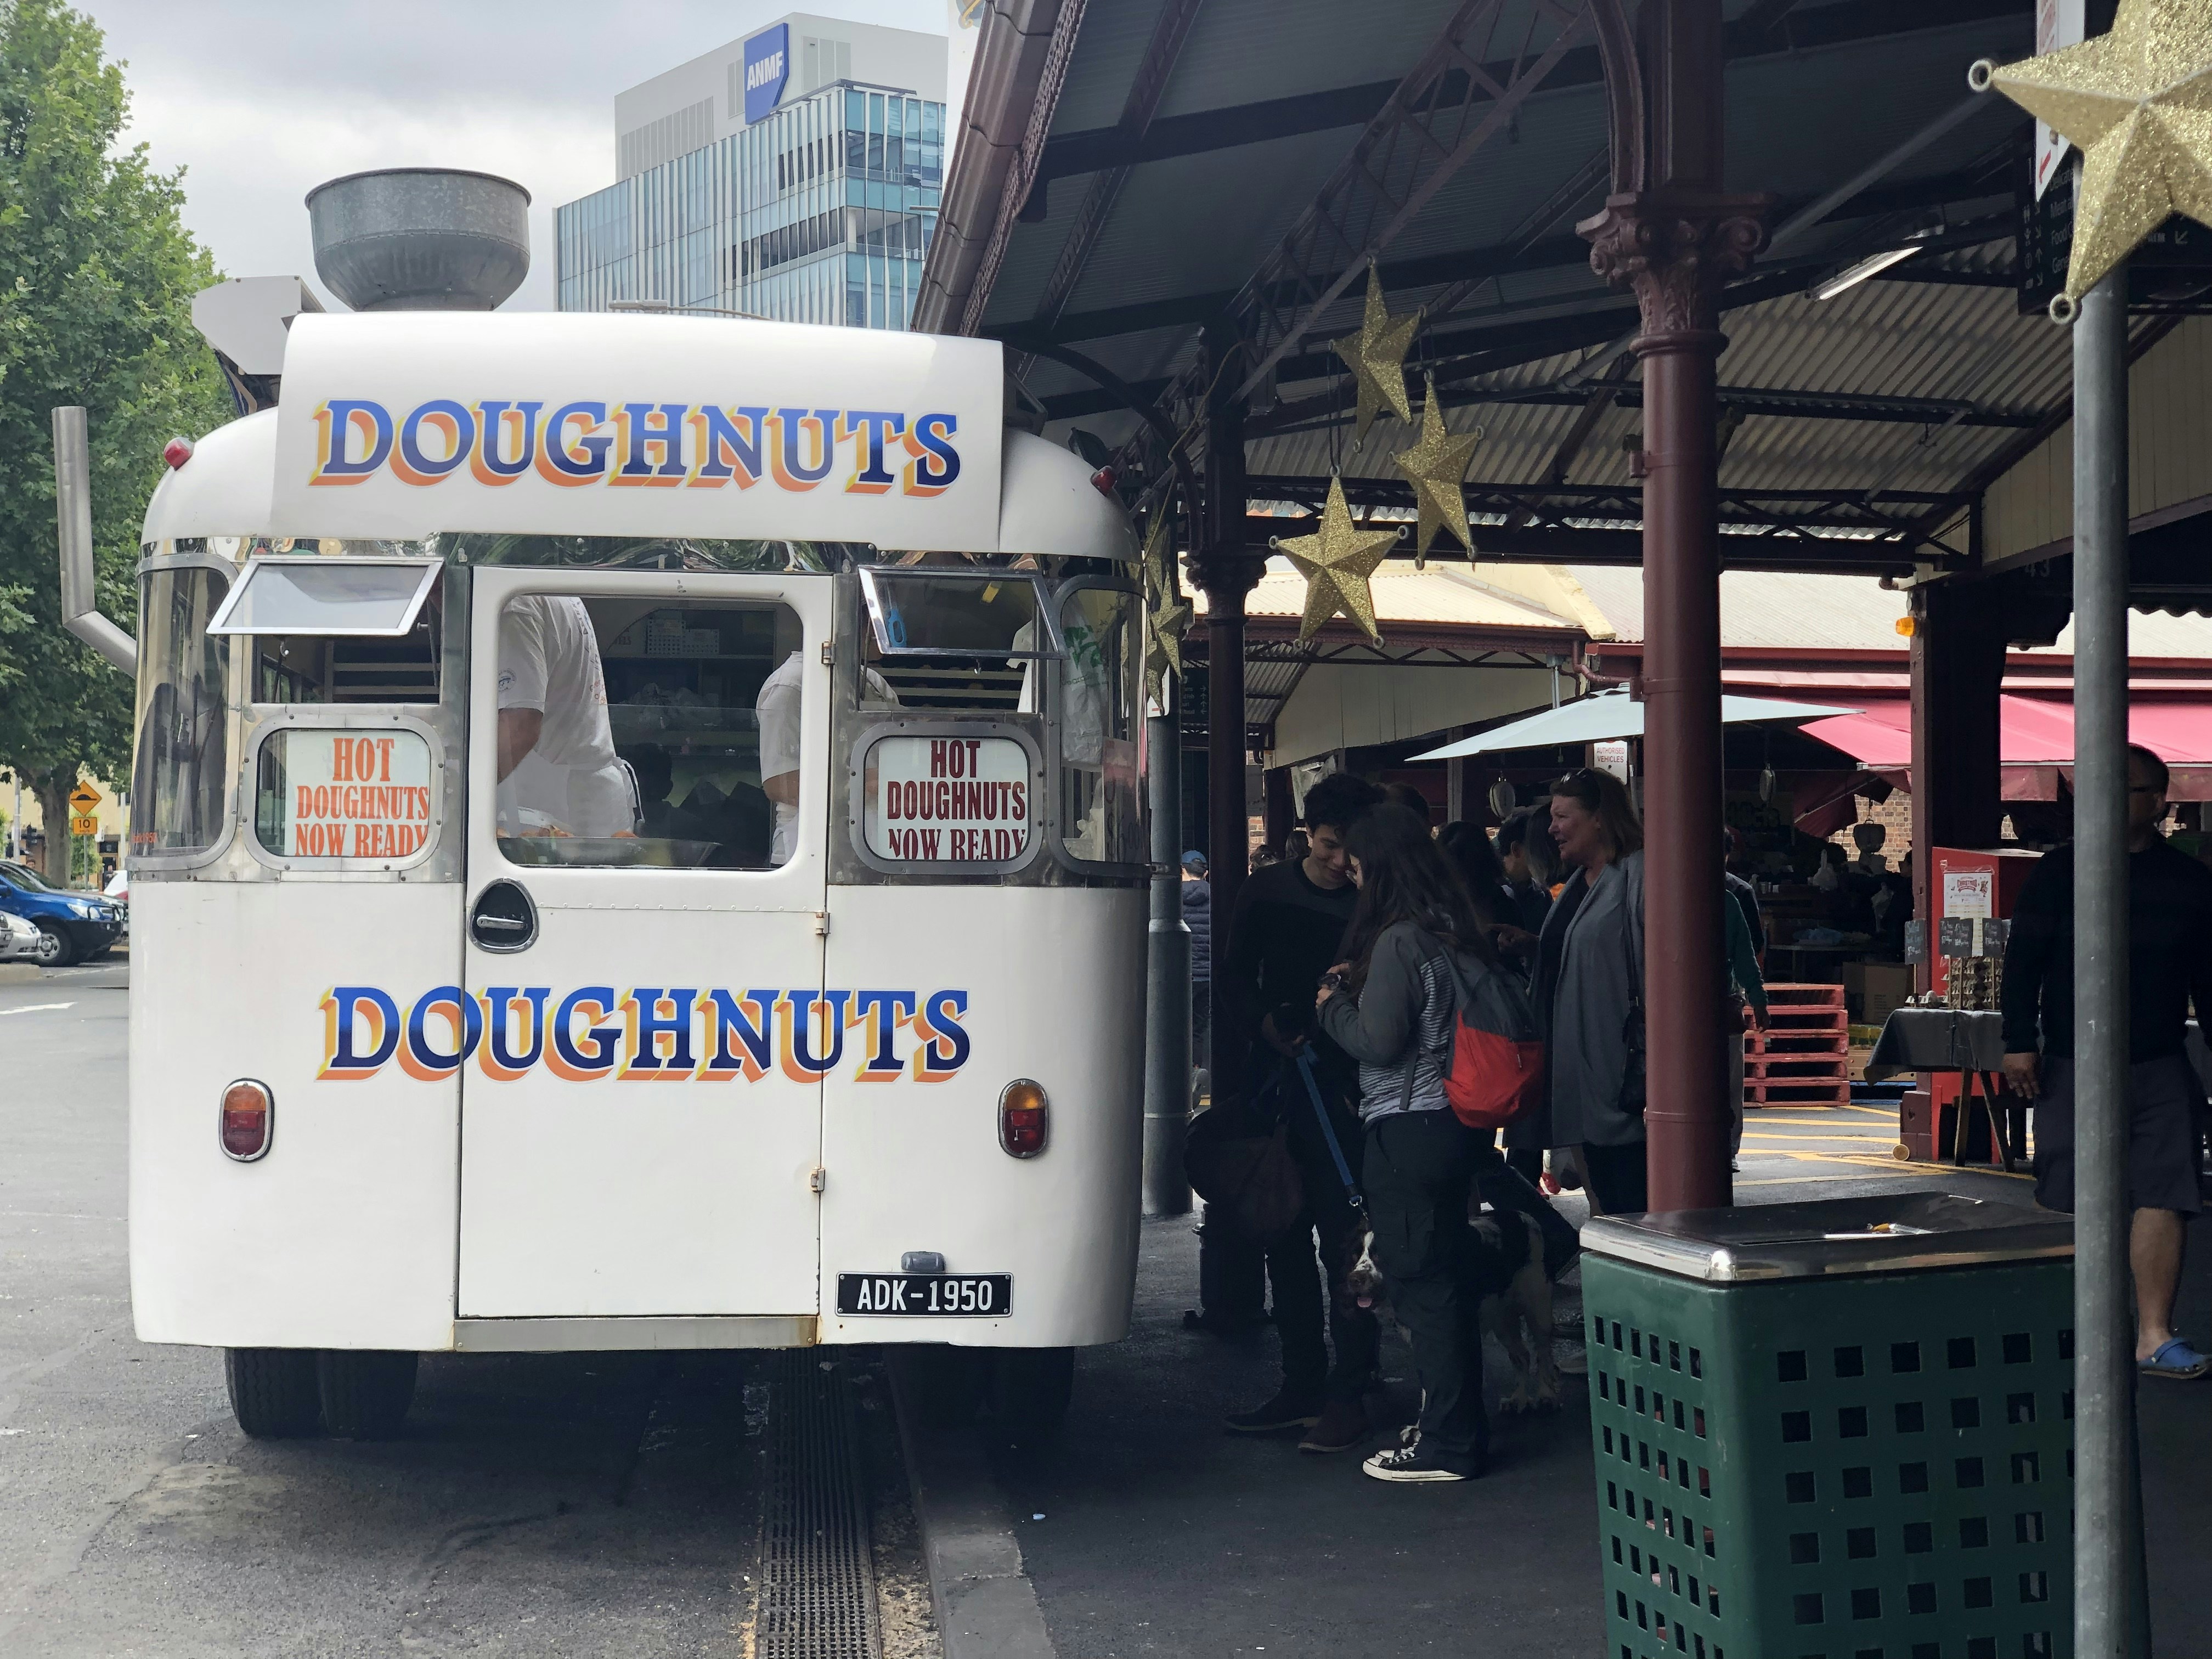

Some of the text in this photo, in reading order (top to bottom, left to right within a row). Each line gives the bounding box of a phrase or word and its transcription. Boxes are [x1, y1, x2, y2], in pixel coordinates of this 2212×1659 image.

[747, 50, 783, 91] ANMF
[308, 399, 961, 498] DOUGHNUTS
[332, 737, 394, 782] HOT
[930, 740, 980, 778] HOT
[296, 785, 429, 820] DOUGHNUTS
[887, 780, 1025, 821] DOUGHNUTS
[78, 819, 91, 828] 10
[295, 823, 428, 857] NOW READY
[888, 828, 1026, 860] NOW READY
[314, 985, 971, 1083] DOUGHNUTS
[857, 1278, 992, 1311] ADK-1950
